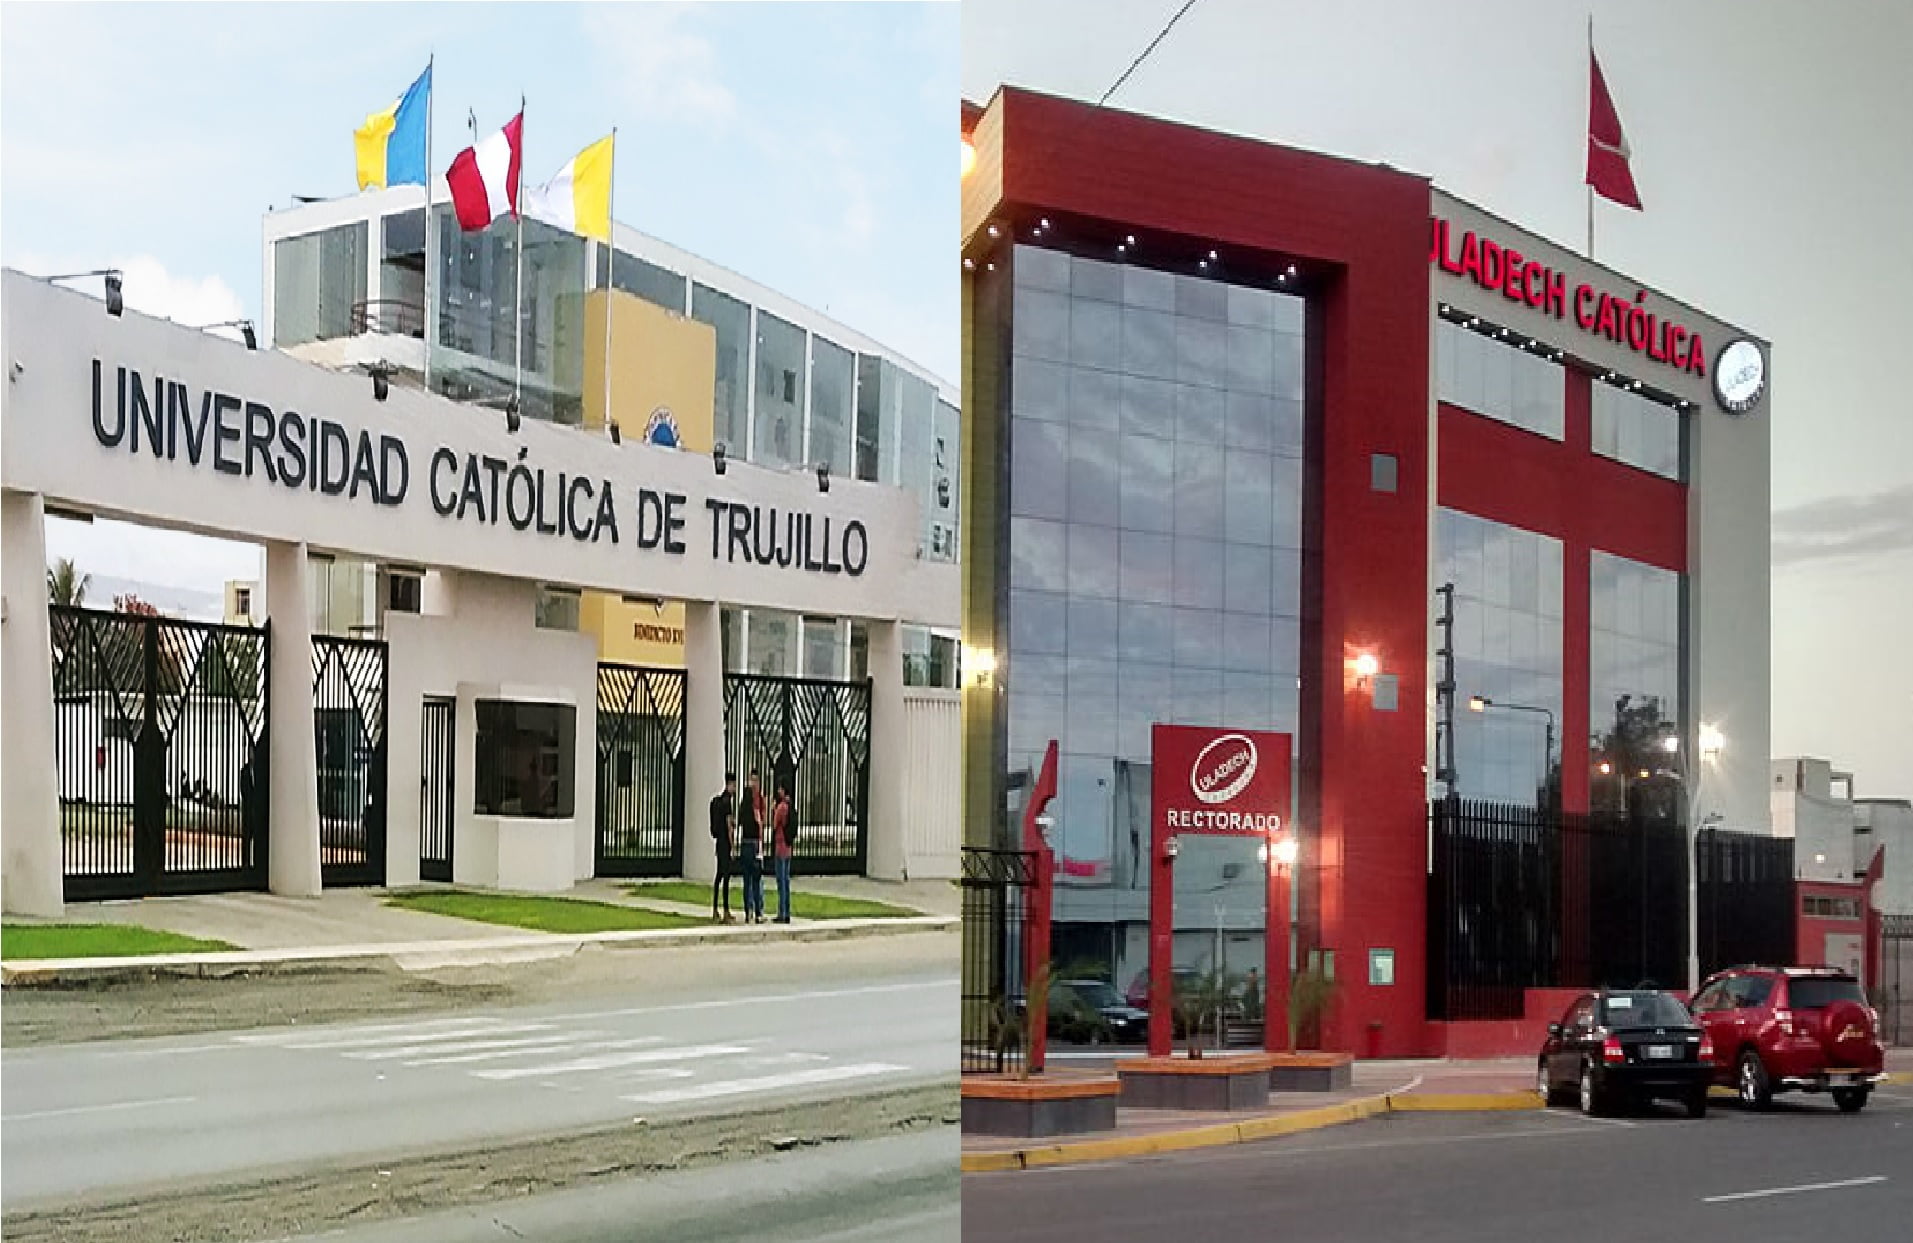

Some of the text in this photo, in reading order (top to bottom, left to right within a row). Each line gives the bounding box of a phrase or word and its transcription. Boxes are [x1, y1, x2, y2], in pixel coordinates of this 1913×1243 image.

[1573, 283, 1706, 377] CATÓLICA
[92, 358, 868, 577] UNIVERSIDAD CATÓLICA DE TRUJILLO
[1199, 748, 1250, 791] ULADECH
[1167, 810, 1281, 832] RECTORADO
